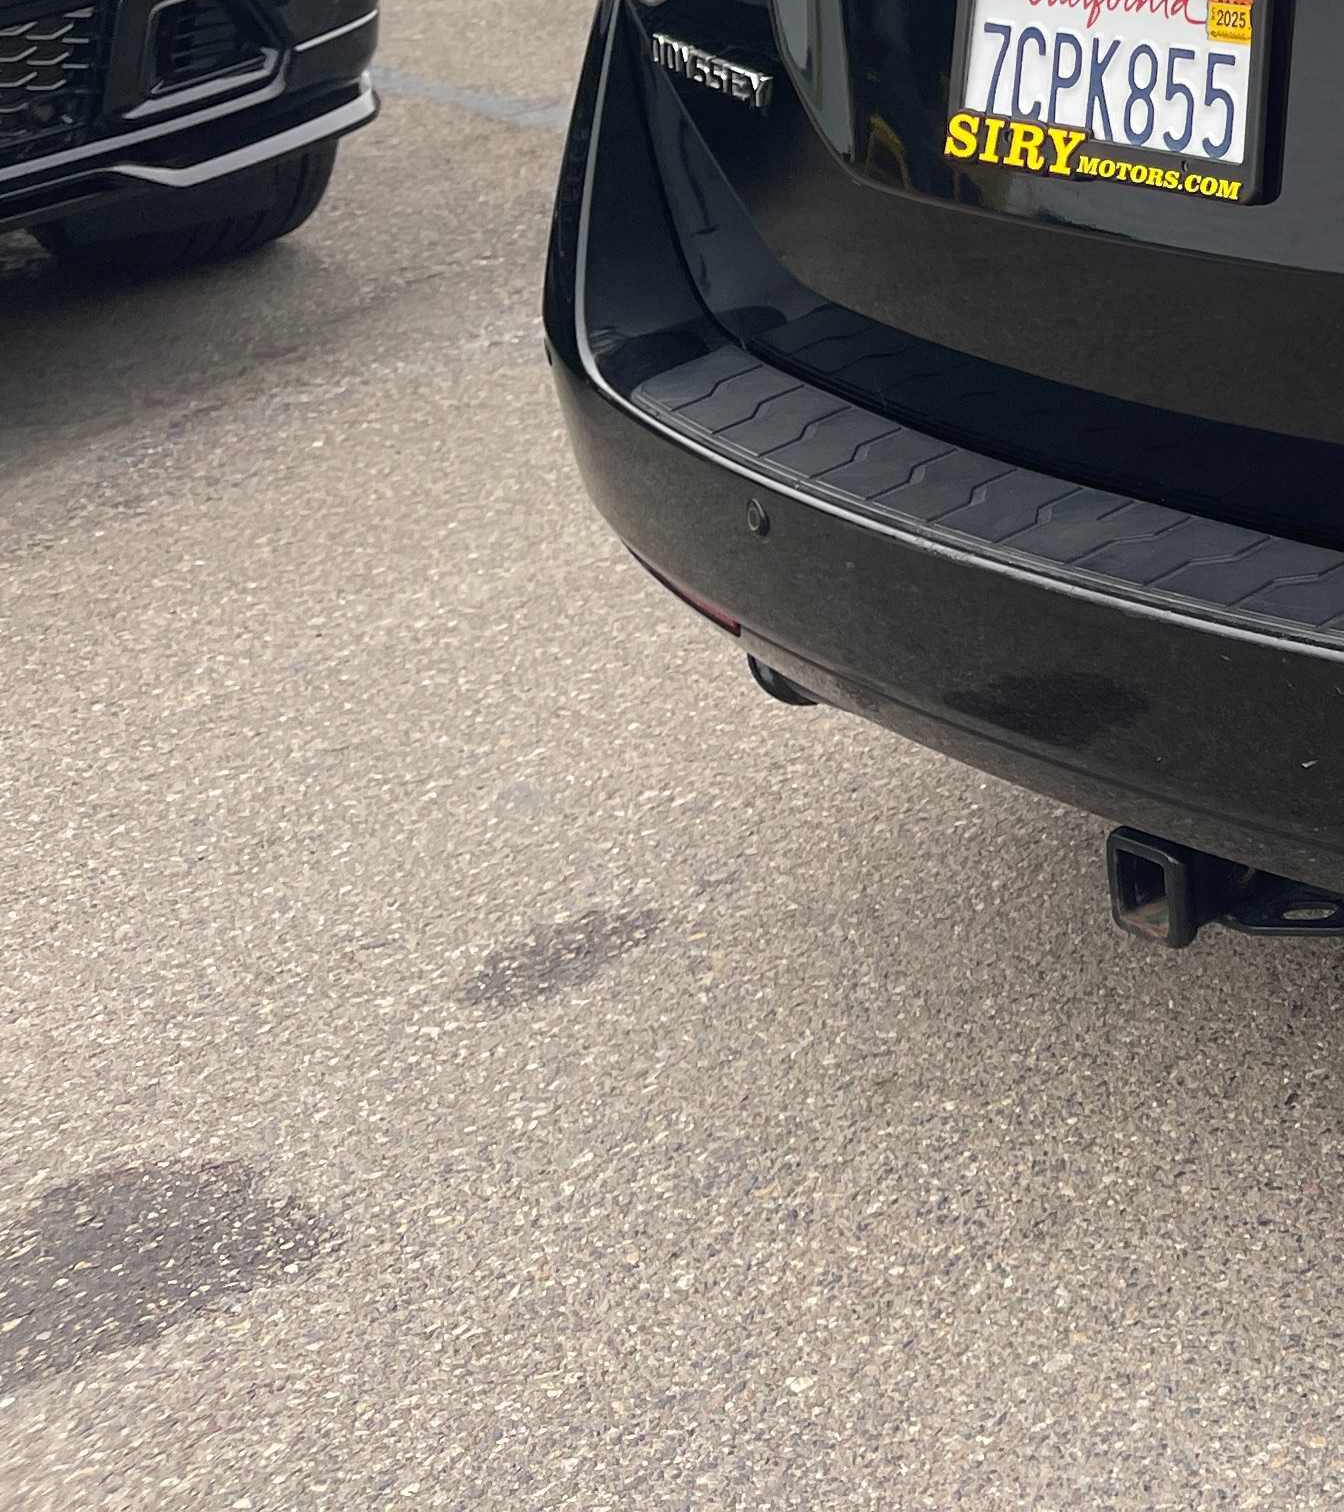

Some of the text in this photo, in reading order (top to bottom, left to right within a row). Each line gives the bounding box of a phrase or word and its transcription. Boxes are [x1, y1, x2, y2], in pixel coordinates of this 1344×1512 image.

[1216, 9, 1247, 29] 2025
[984, 22, 1236, 159] 7CPK855
[944, 113, 1085, 177] SIRY
[1076, 156, 1242, 200] MOTORS.COM
